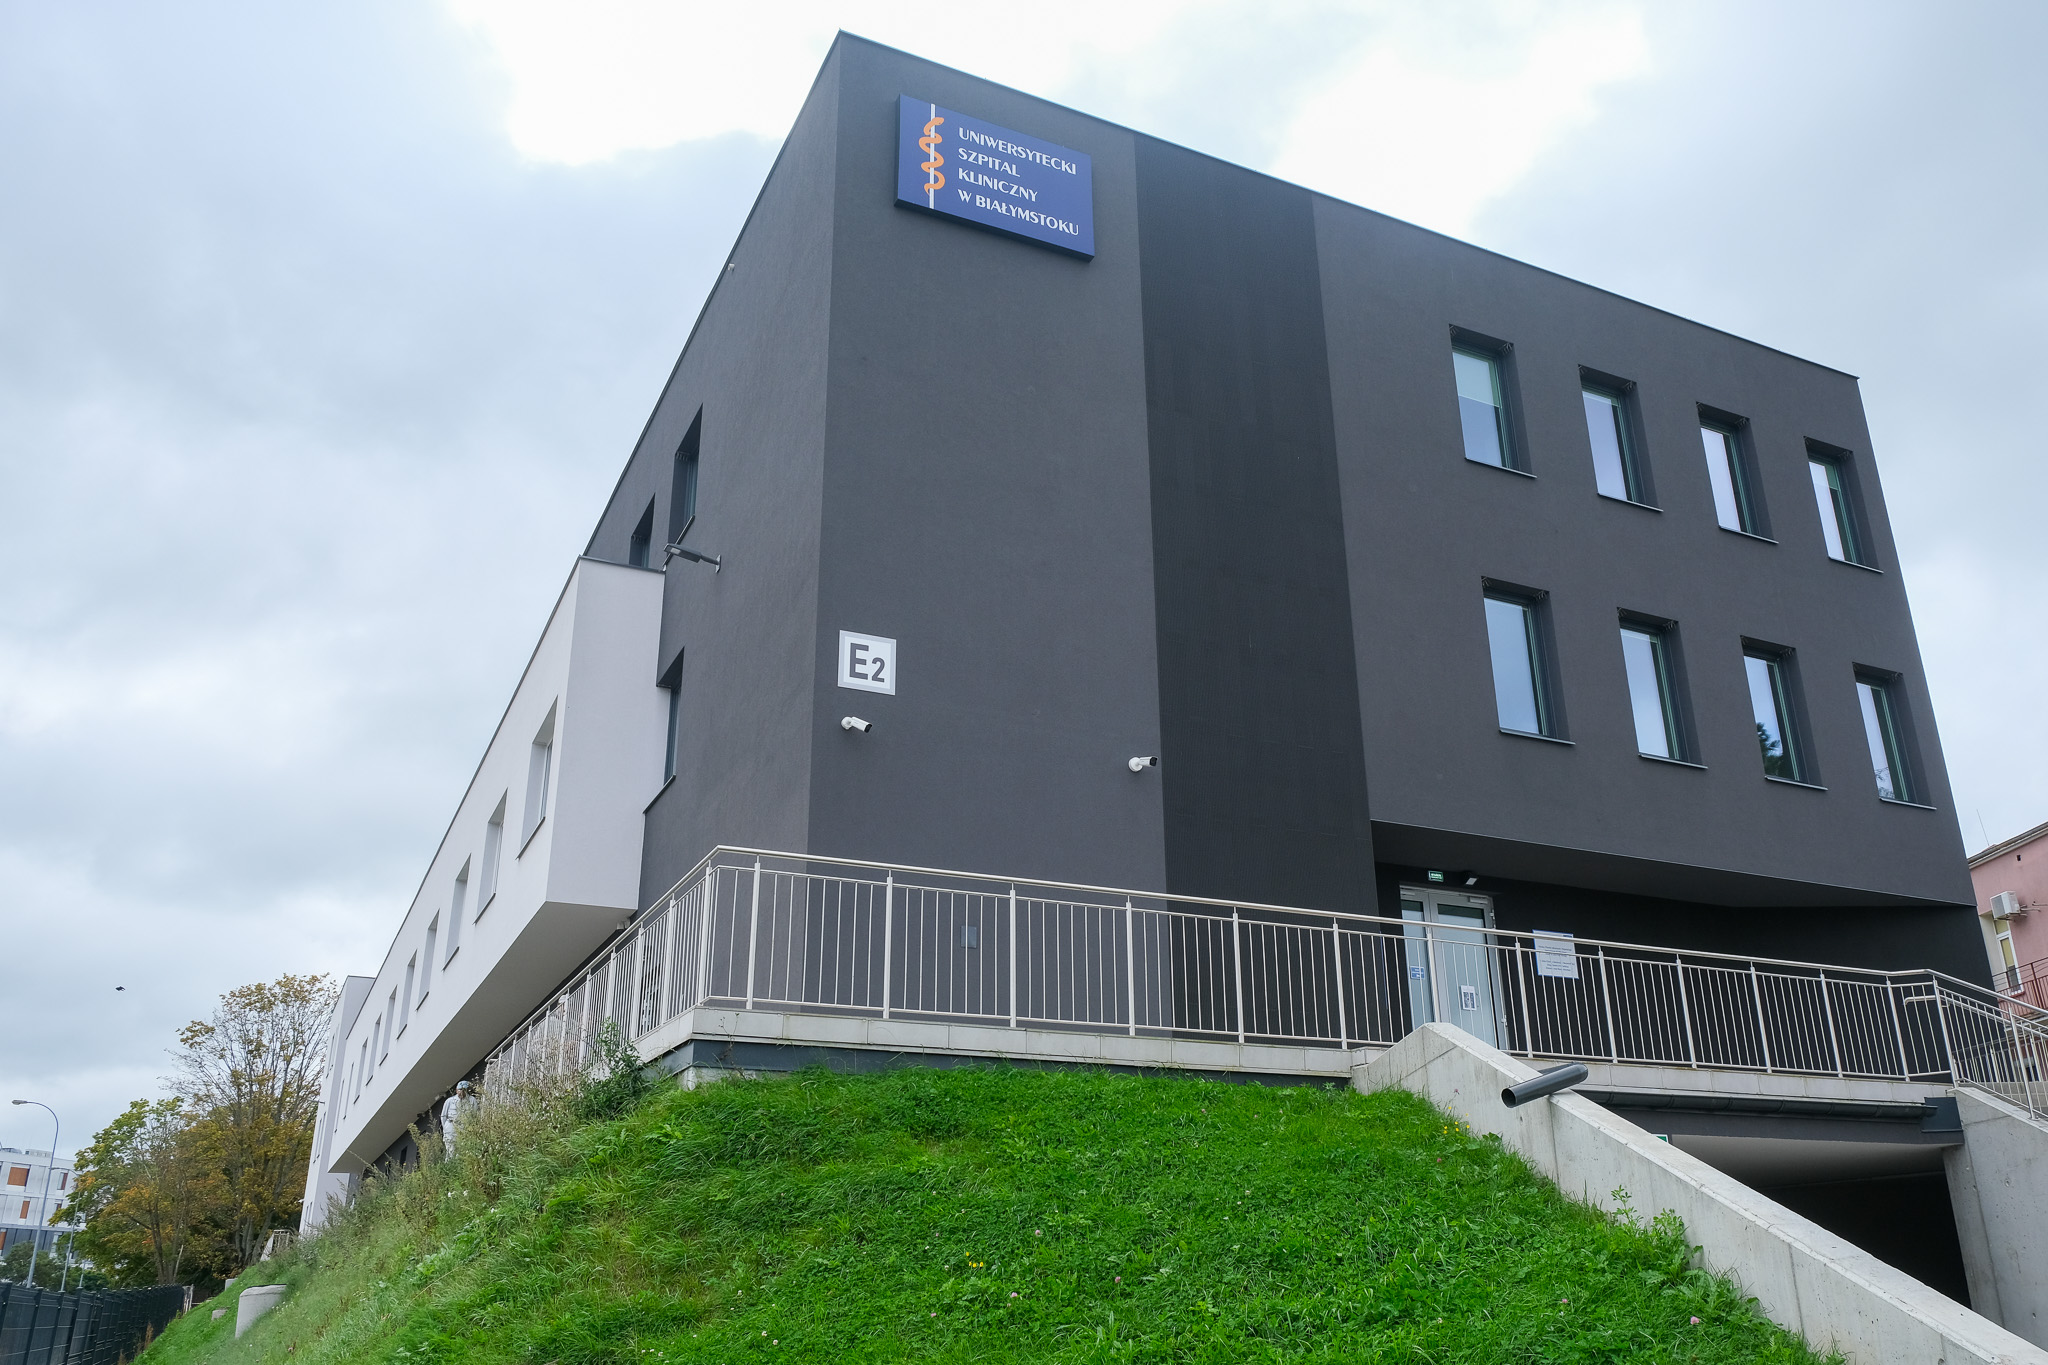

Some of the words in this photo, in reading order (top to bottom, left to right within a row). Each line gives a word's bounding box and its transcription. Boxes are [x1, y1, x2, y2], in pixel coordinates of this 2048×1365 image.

[958, 147, 1020, 177] SZPITAL
[959, 127, 1077, 175] UNIWERSYTECKI
[958, 167, 1038, 202] KLINICZNY
[957, 188, 972, 204] W
[975, 194, 1079, 236] BIAŁYMSTOKU
[849, 642, 885, 683] E2
